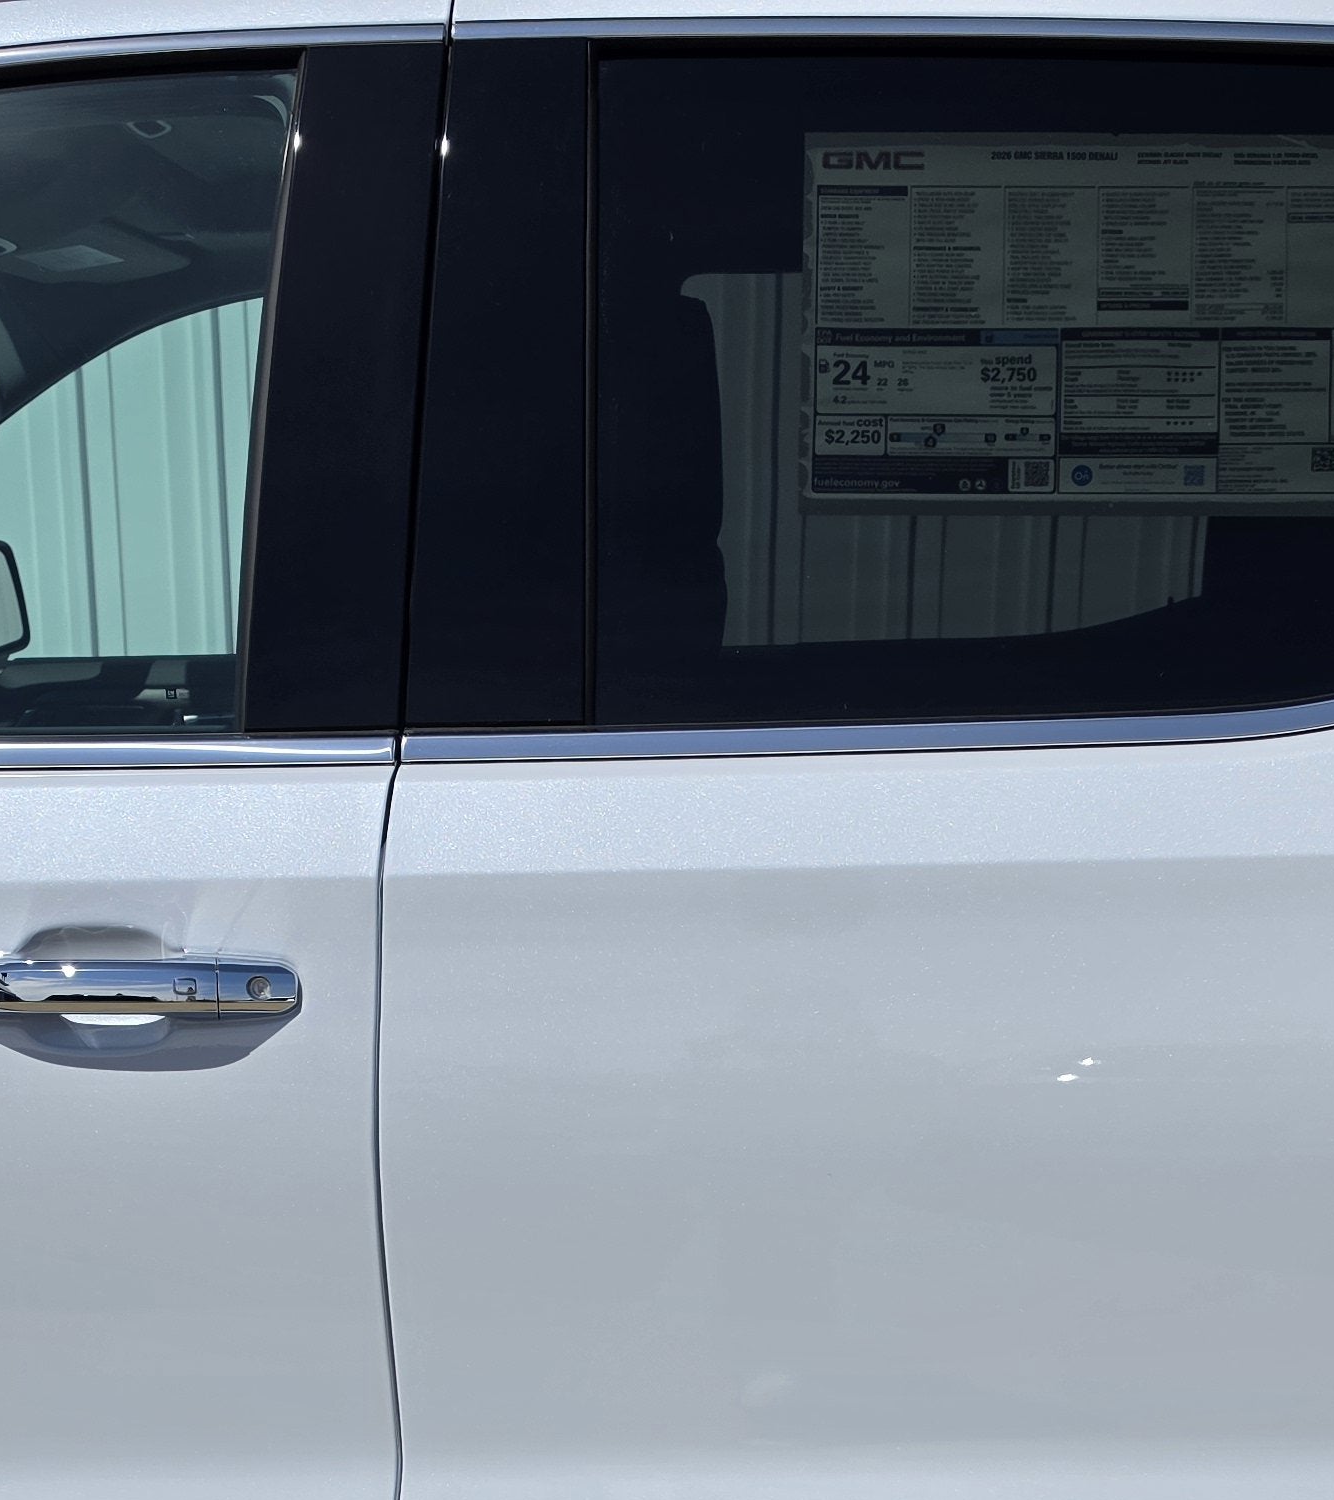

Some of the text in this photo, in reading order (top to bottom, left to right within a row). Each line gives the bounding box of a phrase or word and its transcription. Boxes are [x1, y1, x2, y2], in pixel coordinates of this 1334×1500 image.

[822, 151, 925, 170] GMC
[990, 151, 1118, 161] 2026 GMC SIERRA 1500 DENALI
[835, 332, 965, 344] Fuel Economy and Environment
[874, 360, 894, 368] MPG
[995, 353, 1032, 367] spend
[832, 359, 871, 386] 24
[980, 367, 1037, 384] $2,750
[877, 378, 888, 386] 22
[857, 418, 883, 427] cost
[825, 429, 881, 446] $2,250
[814, 477, 900, 489] fueleconomy.gov
